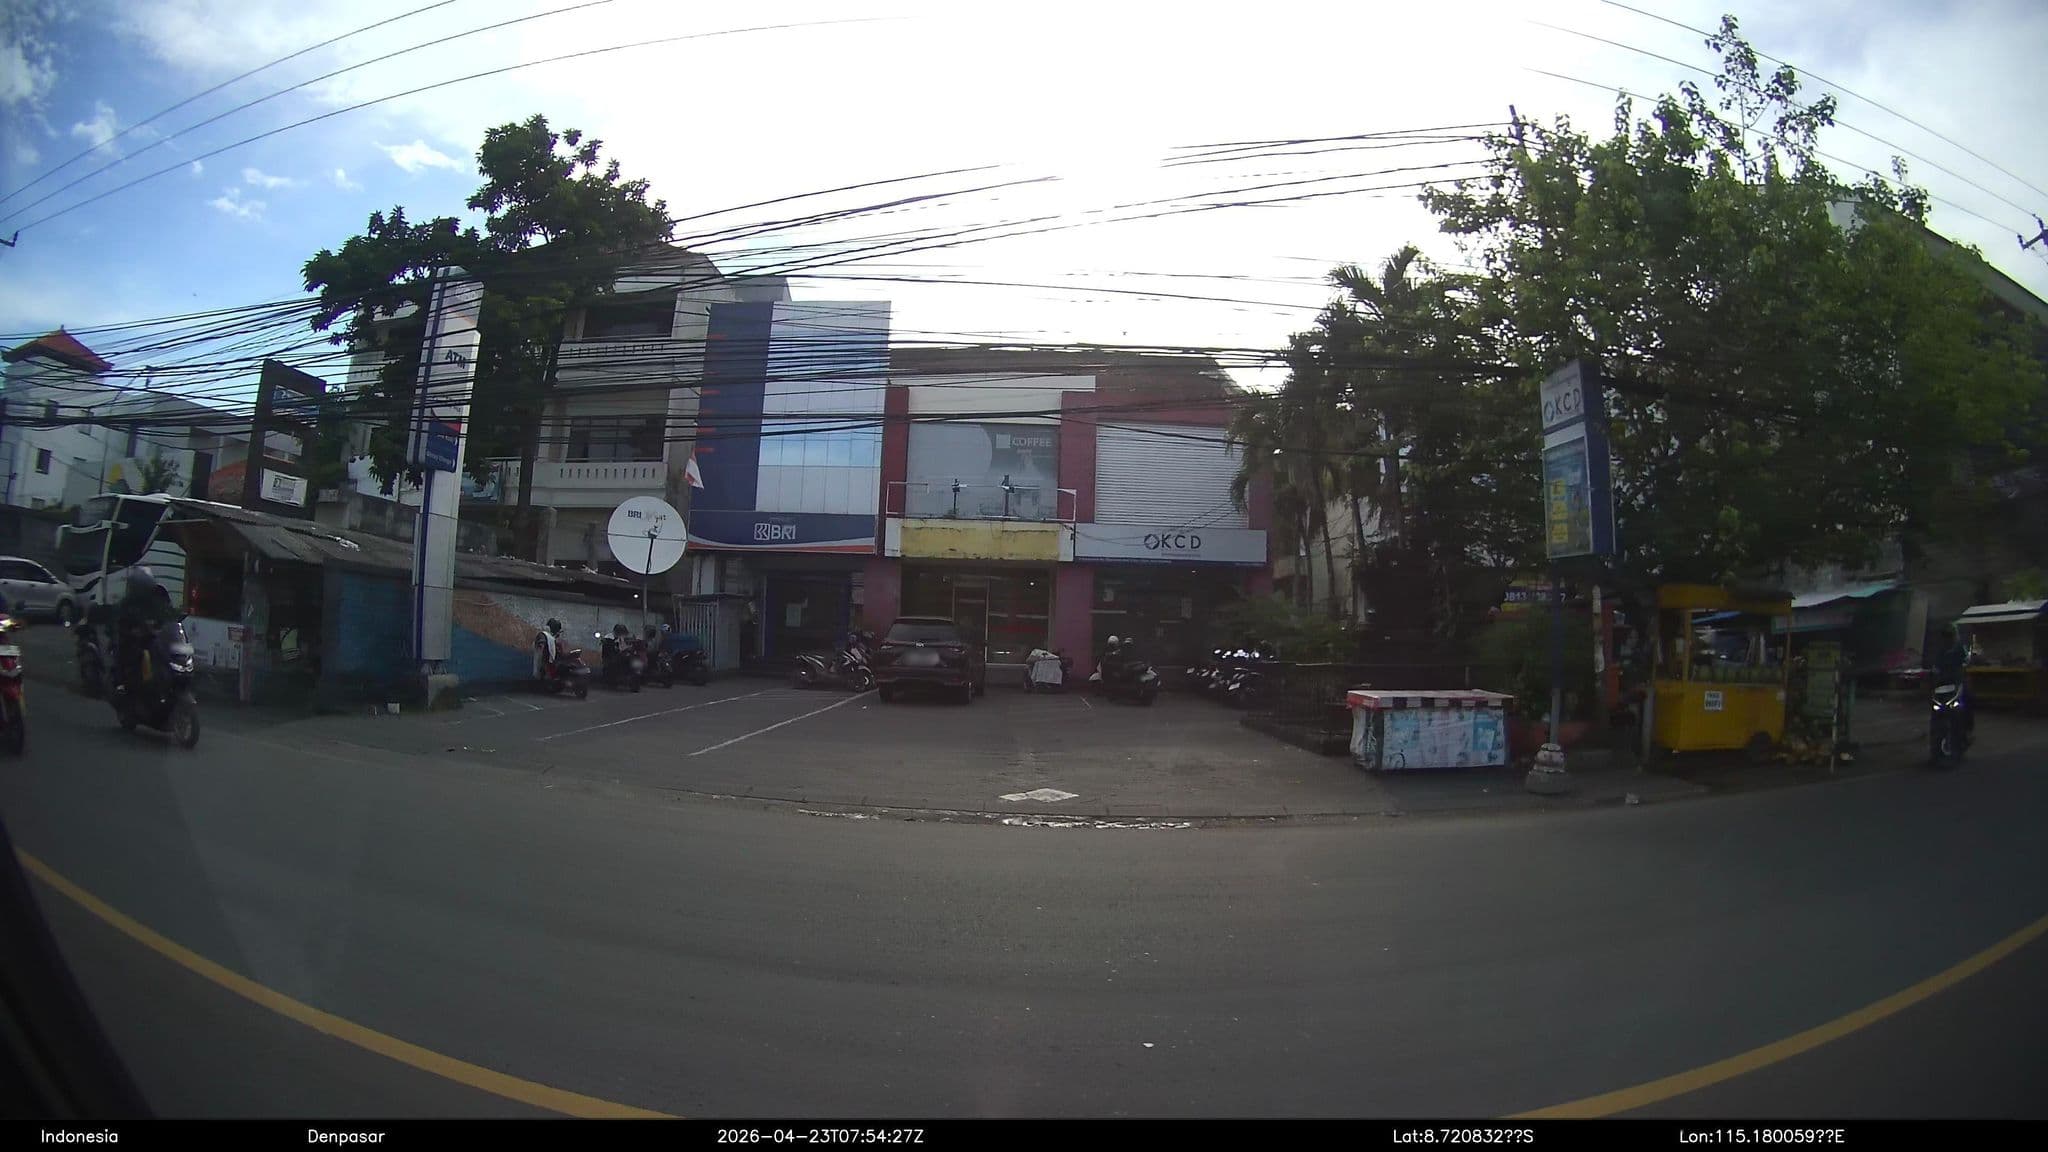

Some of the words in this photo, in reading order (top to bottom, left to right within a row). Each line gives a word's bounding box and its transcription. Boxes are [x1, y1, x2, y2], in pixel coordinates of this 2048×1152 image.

[445, 349, 466, 370] ATM
[1012, 436, 1053, 448] COFFEE
[627, 510, 642, 519] BRI
